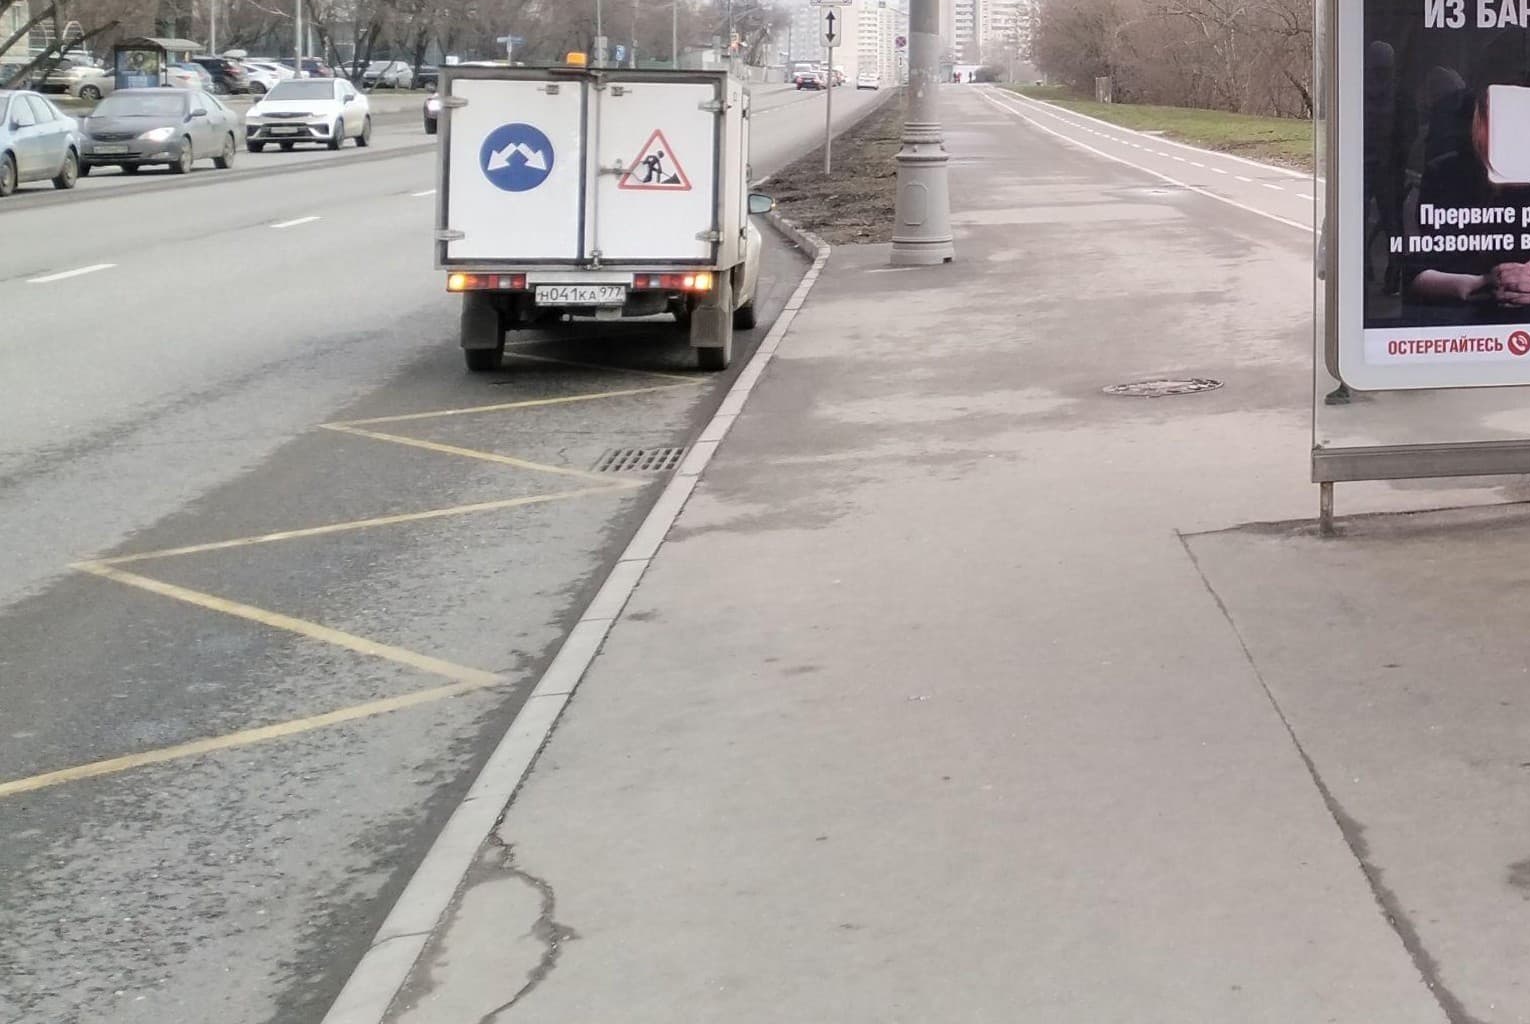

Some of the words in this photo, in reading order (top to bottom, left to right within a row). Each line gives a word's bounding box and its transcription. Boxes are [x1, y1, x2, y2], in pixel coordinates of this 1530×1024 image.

[1420, 203, 1516, 229] Прервите
[1390, 236, 1402, 253] и
[1408, 232, 1515, 253] позвоните
[1388, 334, 1503, 356] ОСТЕРЕГАЙТЕСЬ
